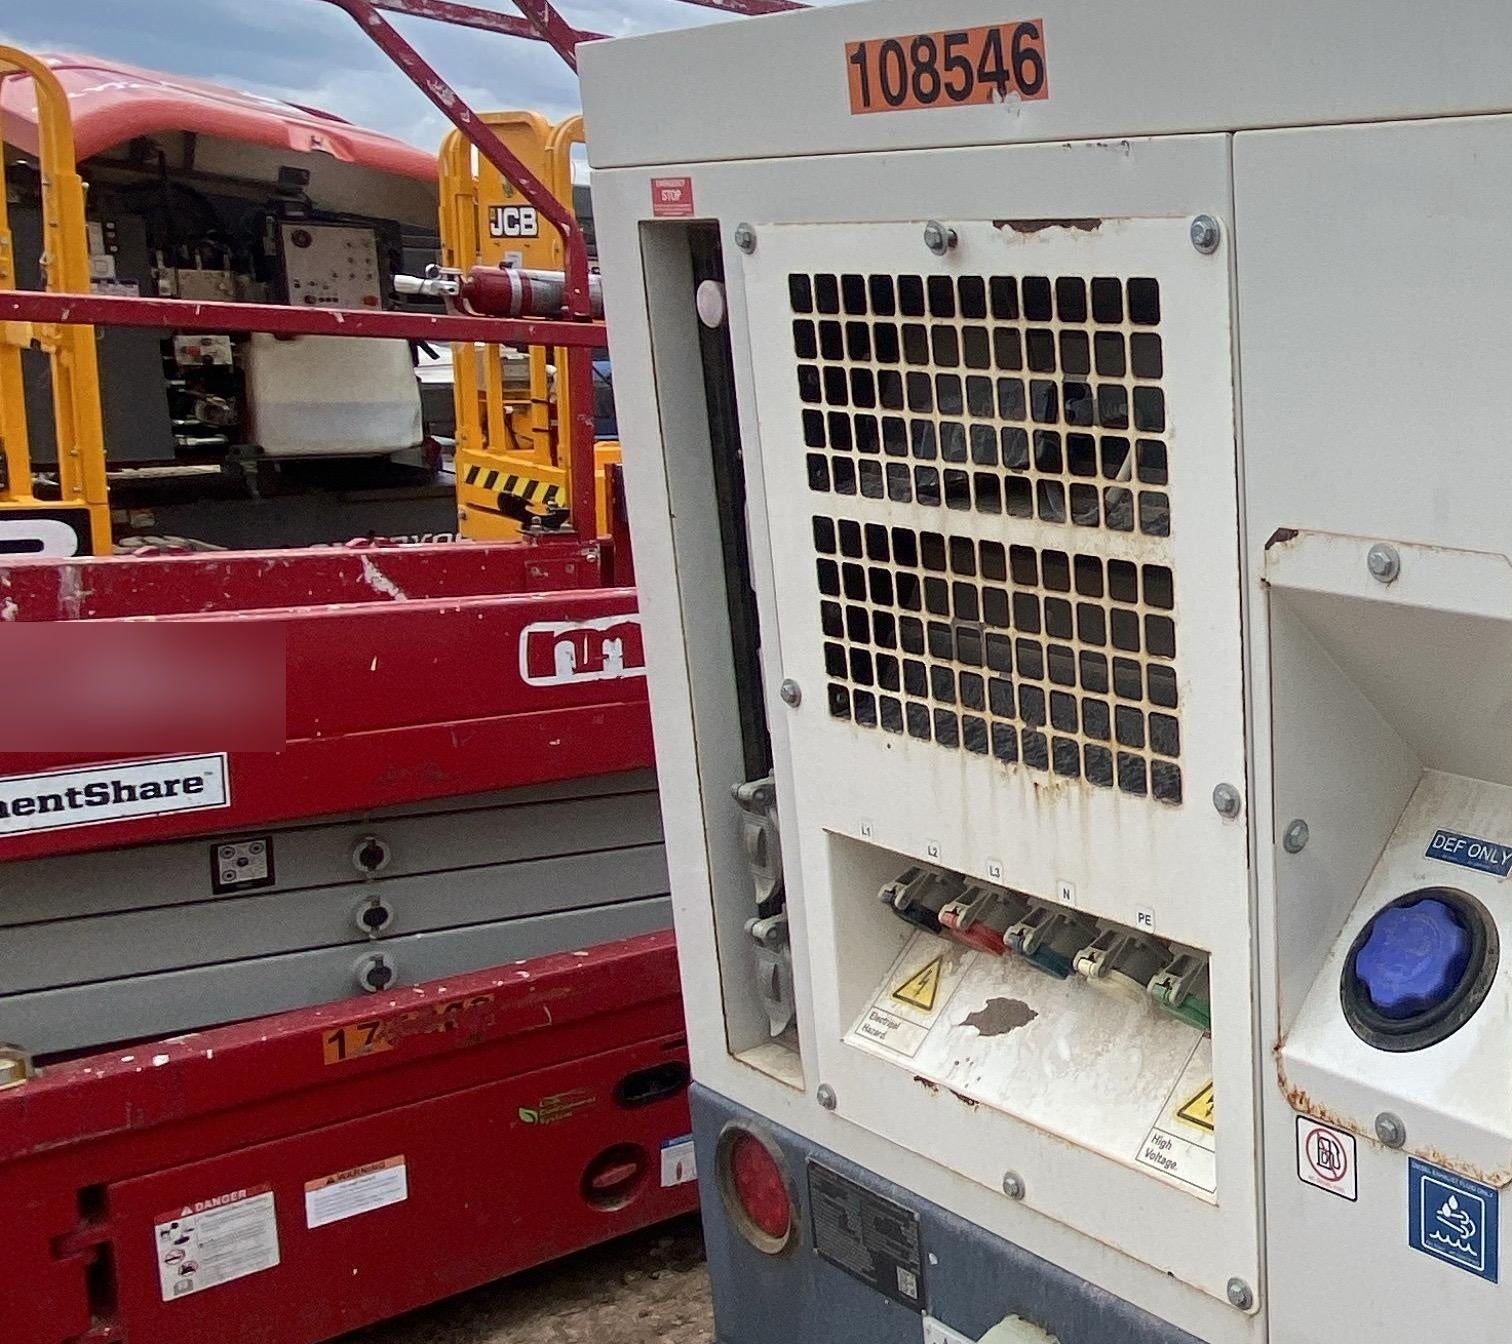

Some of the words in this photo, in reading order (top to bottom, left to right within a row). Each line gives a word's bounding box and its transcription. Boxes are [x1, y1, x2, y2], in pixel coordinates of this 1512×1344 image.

[850, 22, 1044, 108] 108546
[661, 189, 682, 202] STOP
[490, 206, 538, 236] JCB
[860, 825, 871, 836] L1
[1432, 834, 1467, 853] DEF
[927, 845, 938, 857] L2
[989, 866, 1001, 878] L3
[1062, 888, 1071, 900] N
[1138, 912, 1152, 926] PE
[1151, 1133, 1173, 1151] High
[195, 1189, 247, 1212] DANGER
